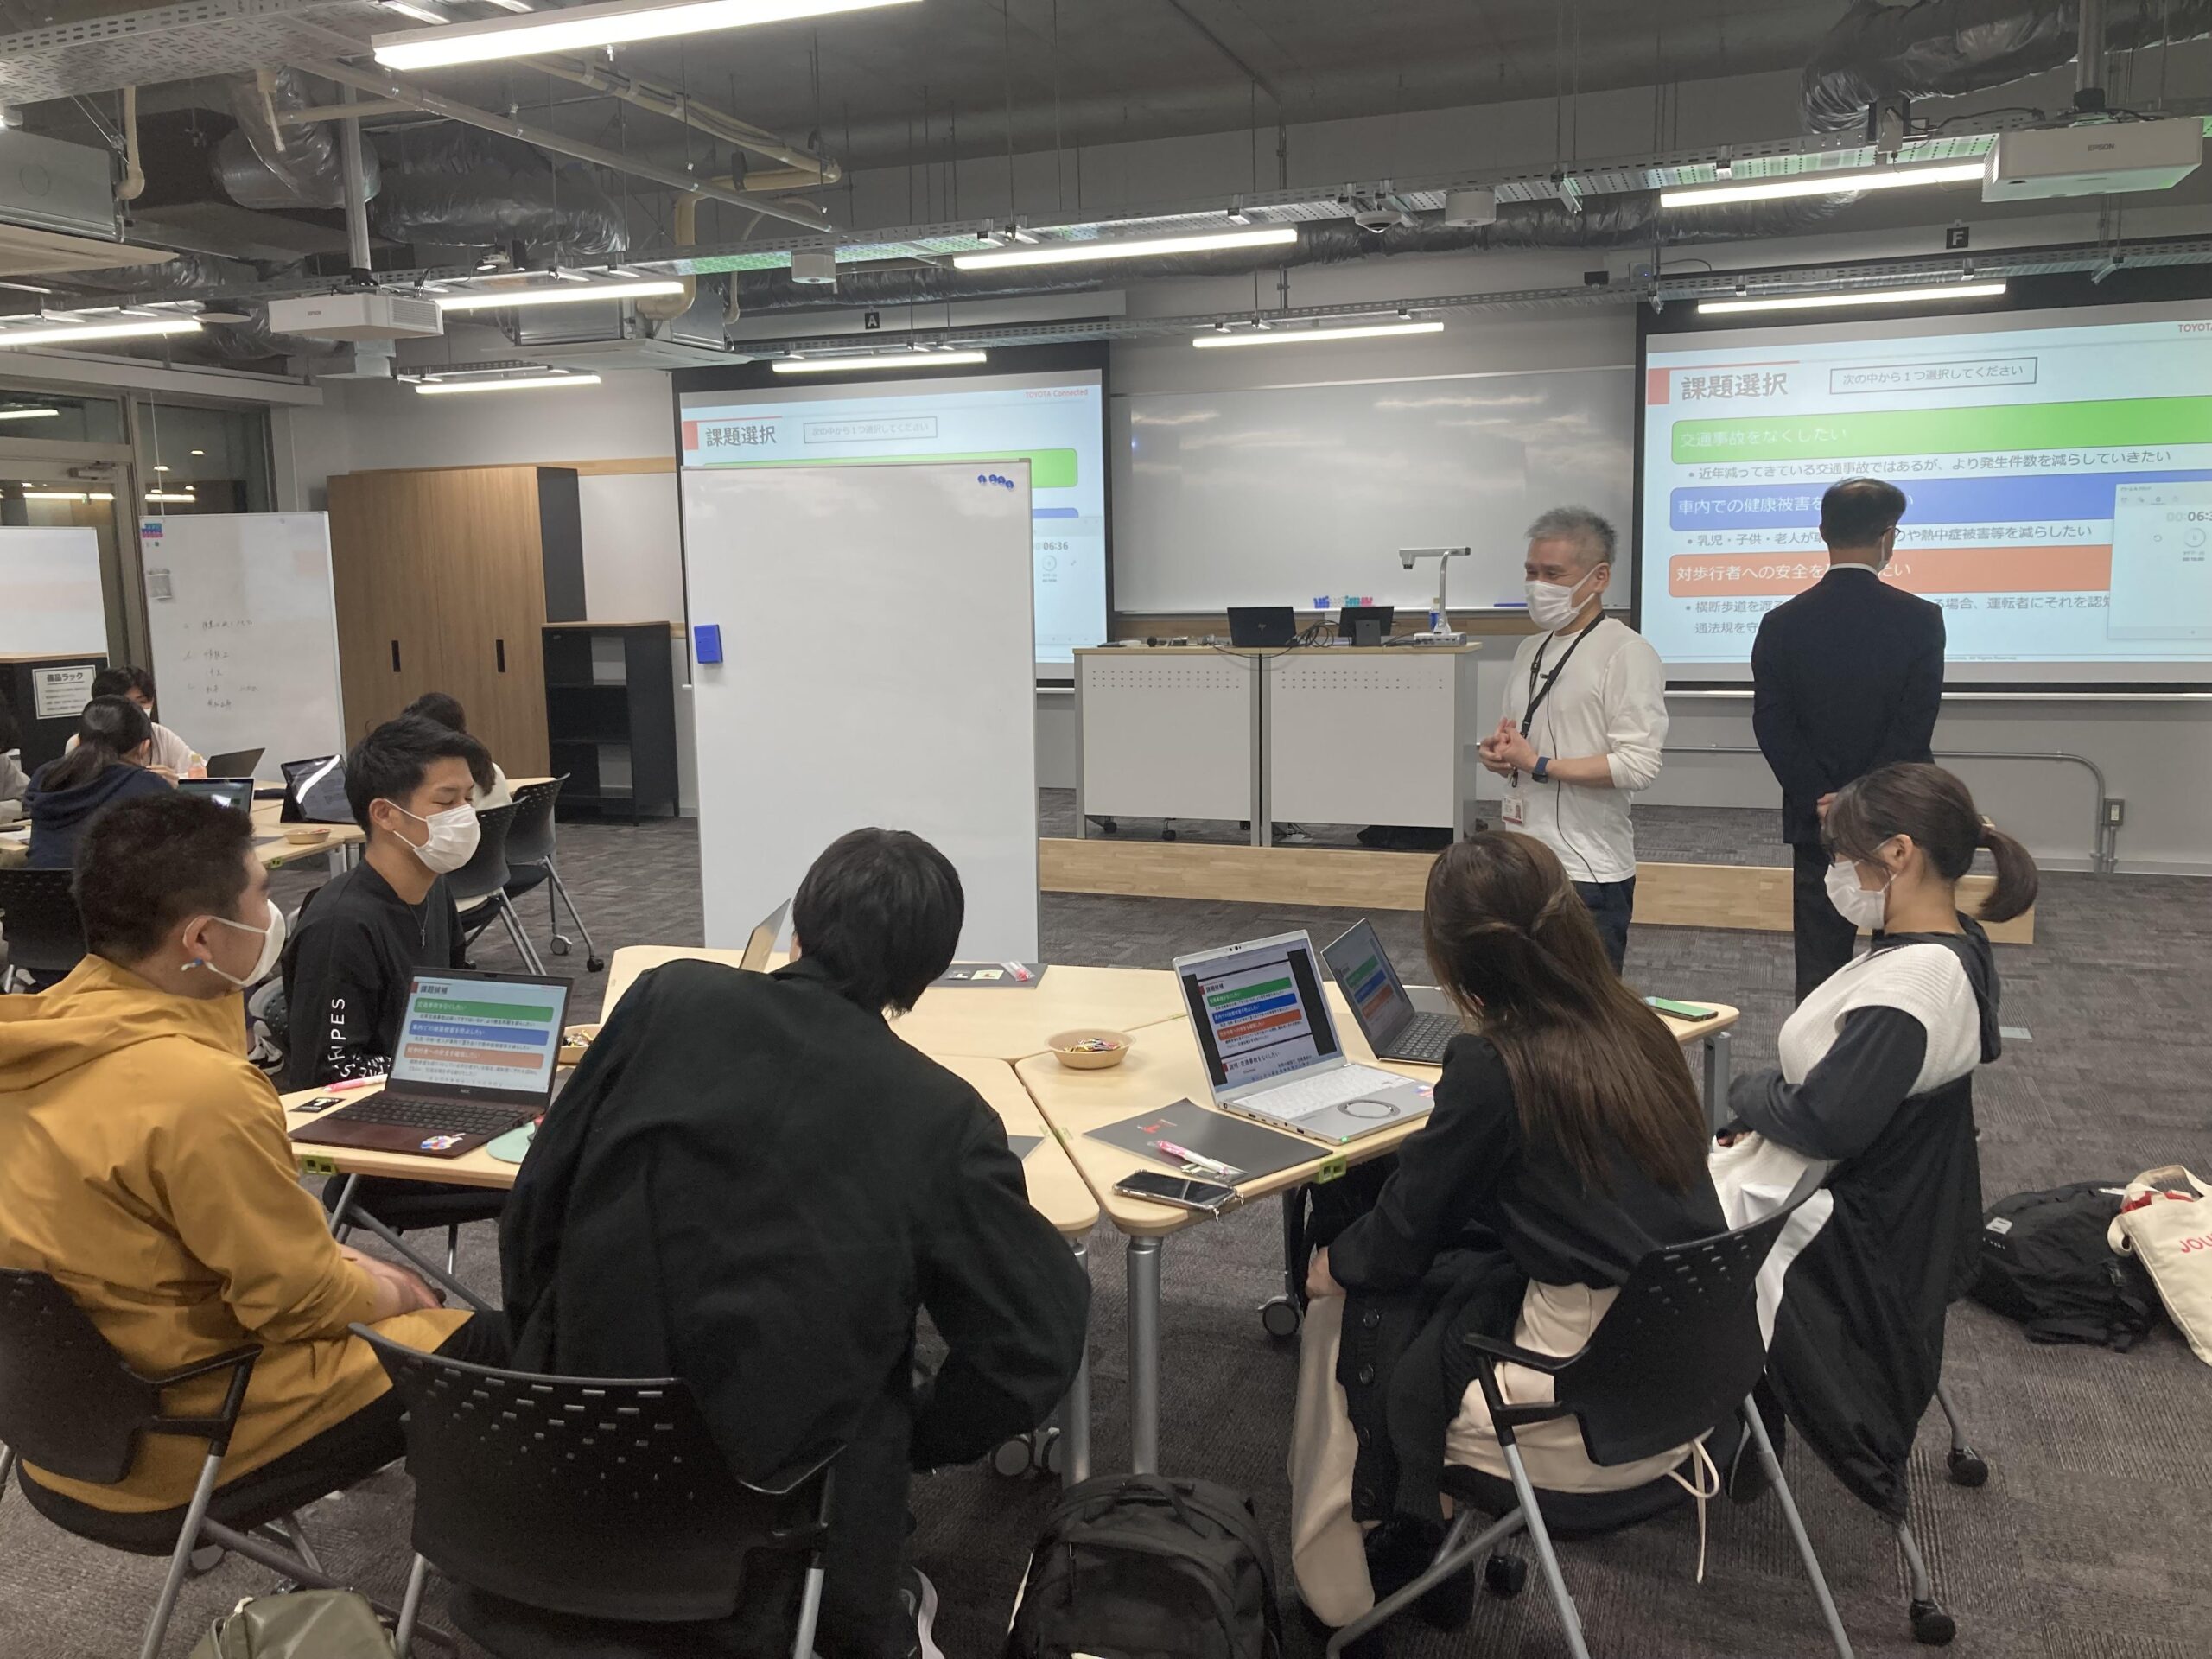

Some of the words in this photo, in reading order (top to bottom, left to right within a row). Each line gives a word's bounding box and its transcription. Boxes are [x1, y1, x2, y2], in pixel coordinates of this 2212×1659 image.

[2088, 143, 2115, 152] EPSON
[1952, 231, 1964, 245] F
[868, 315, 878, 327] A
[2178, 322, 2212, 333] TOYOT
[1681, 372, 1789, 400] 課題選択
[1026, 390, 1052, 398] TOYOTA
[705, 424, 777, 447] 課題選択
[1679, 428, 1847, 448] 交通事故をなくしたい
